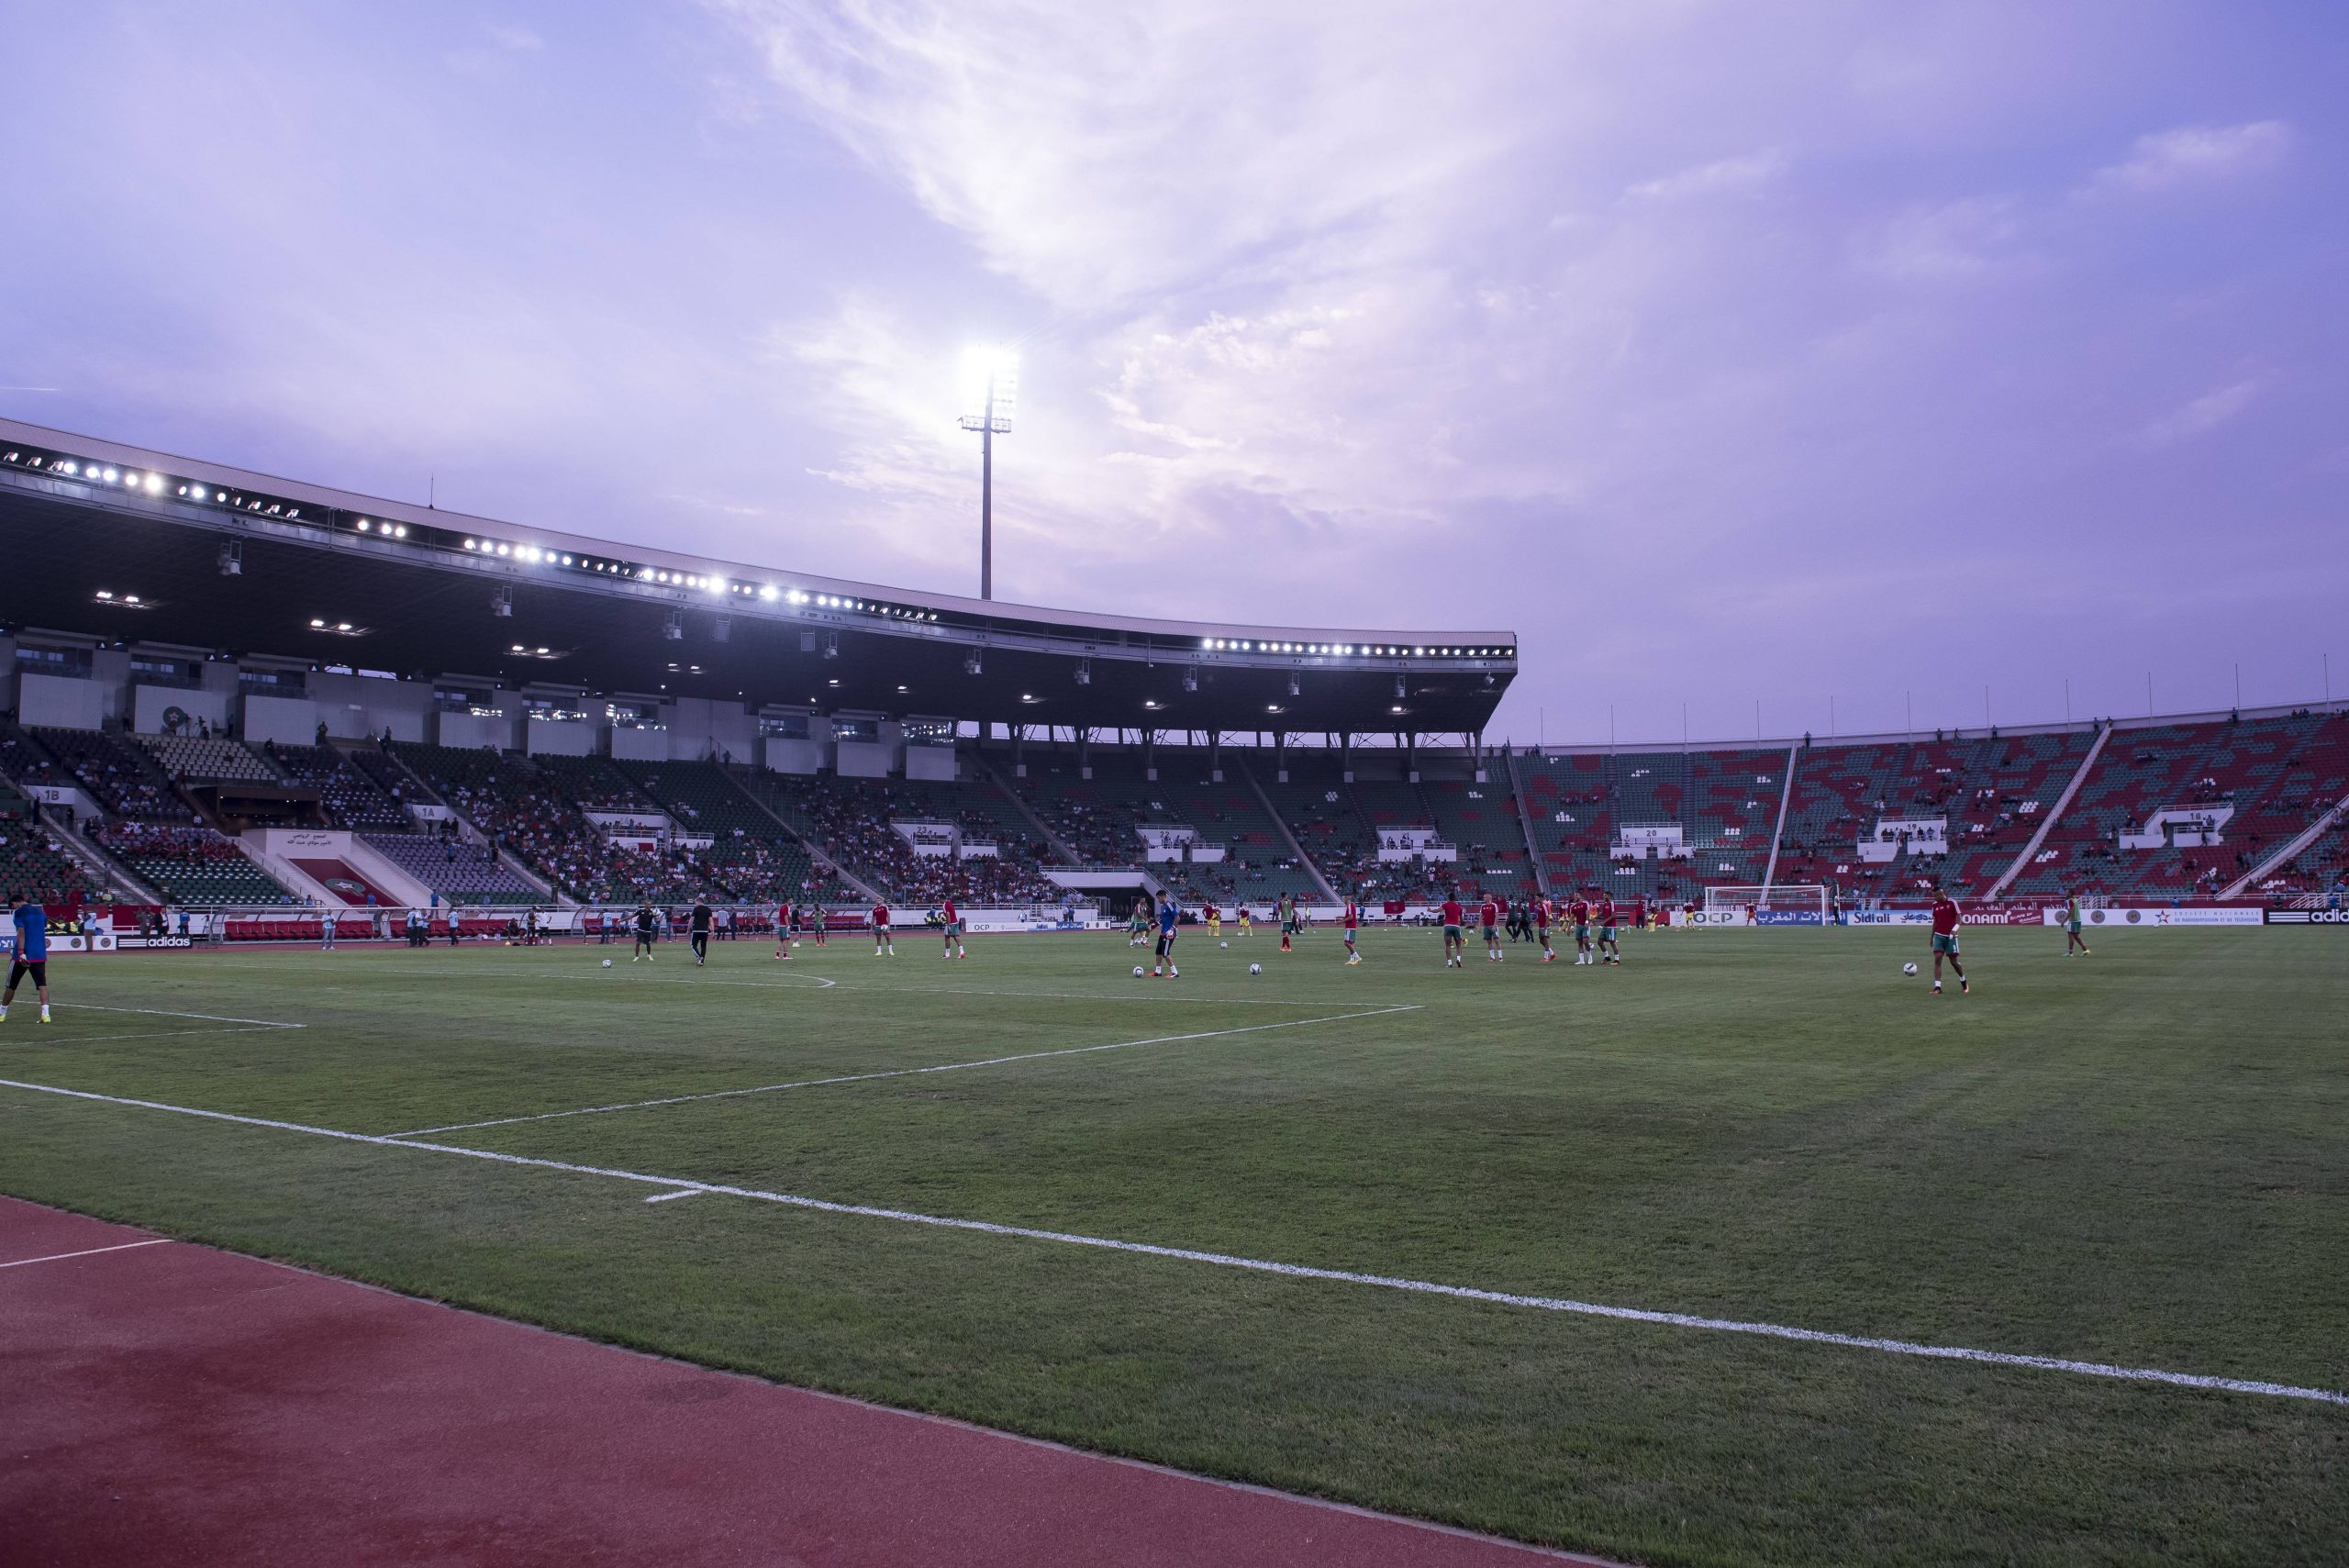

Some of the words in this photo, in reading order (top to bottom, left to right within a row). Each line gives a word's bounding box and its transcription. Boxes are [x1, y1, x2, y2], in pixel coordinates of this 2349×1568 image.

[45, 790, 60, 800] 1B
[422, 808, 435, 817] 1A
[1693, 913, 1733, 923] OCP
[1854, 912, 1875, 923] Sidi
[1876, 914, 1890, 923] ali
[1963, 911, 2011, 924] ONAMI
[148, 936, 191, 947] adidas
